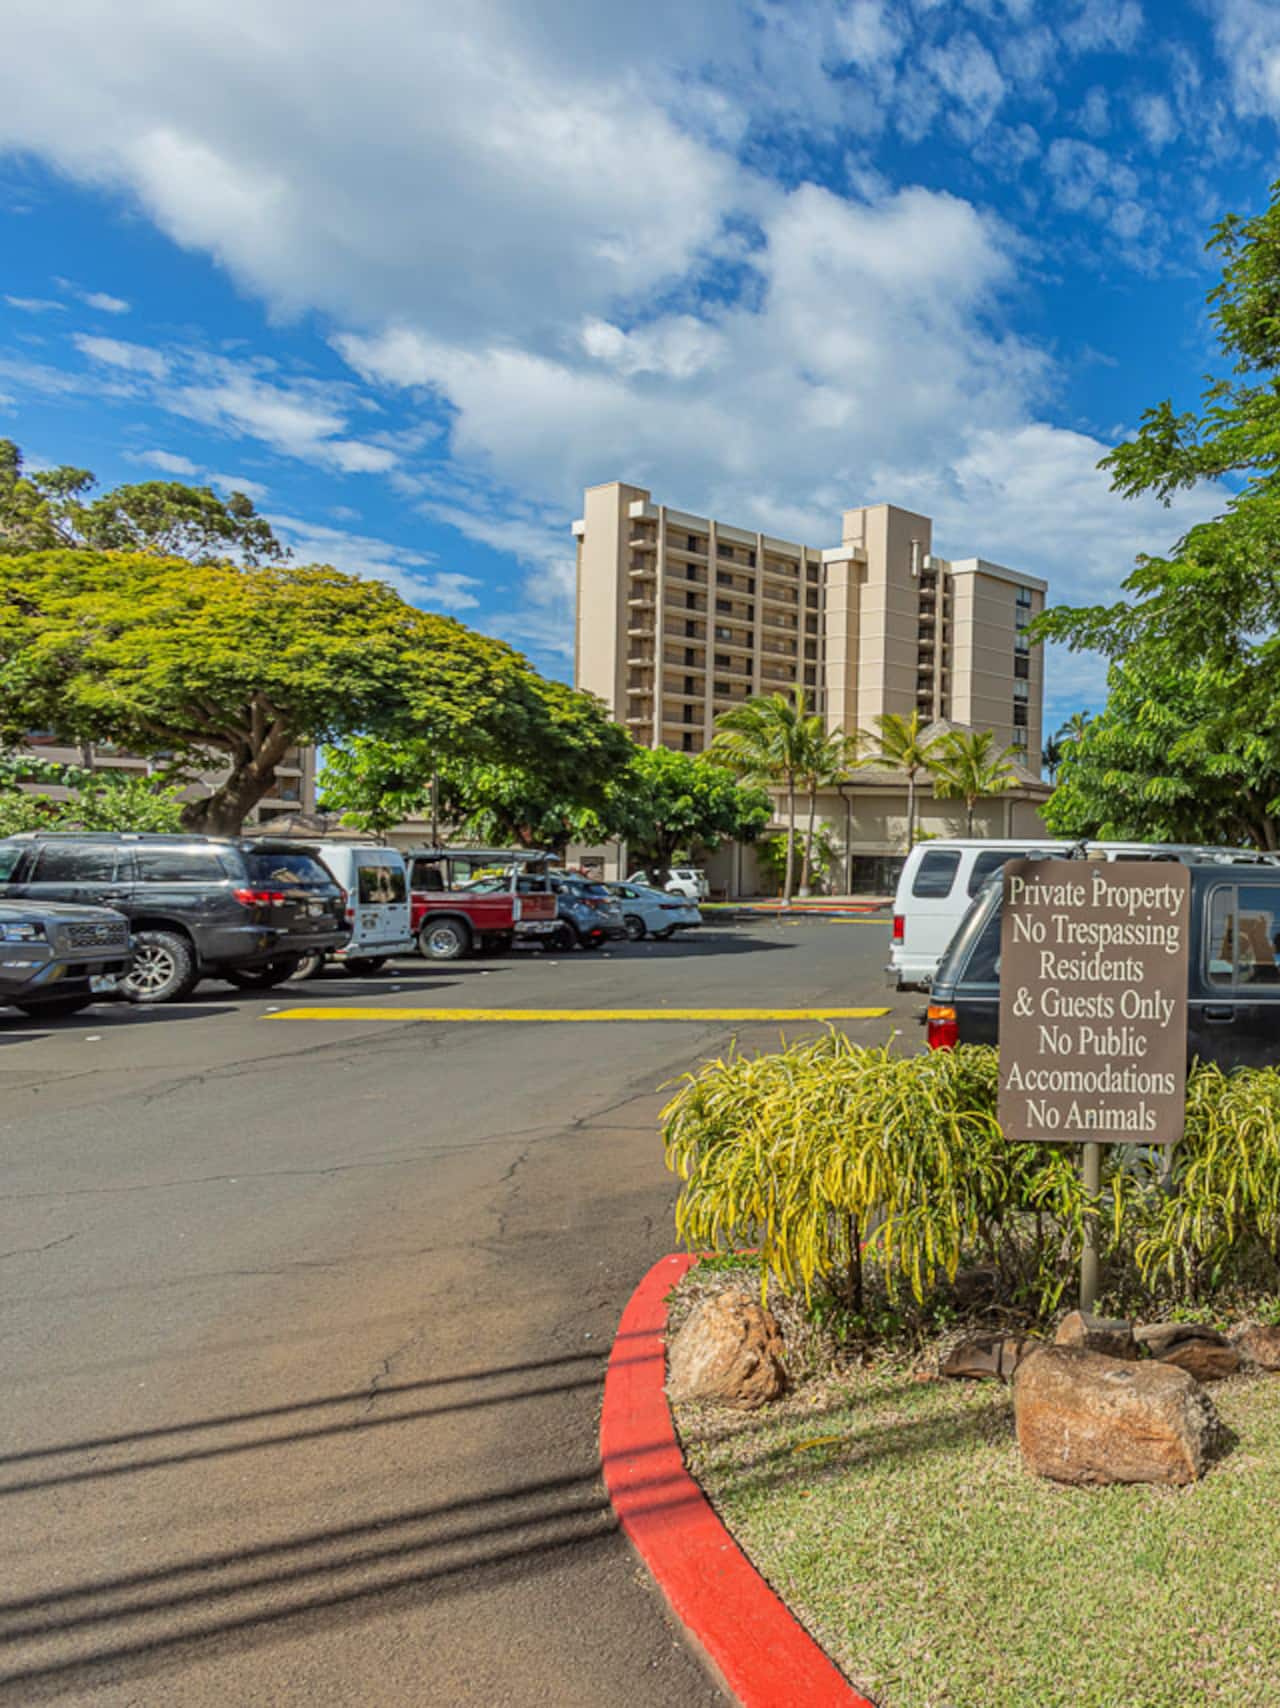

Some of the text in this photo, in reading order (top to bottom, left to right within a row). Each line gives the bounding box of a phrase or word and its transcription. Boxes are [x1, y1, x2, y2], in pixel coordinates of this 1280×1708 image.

[1009, 875, 1184, 916] Private Property
[1012, 913, 1180, 954] No Trespassing
[1039, 951, 1144, 981] Residents
[1012, 986, 1175, 1027] & Guests Only
[1038, 1025, 1147, 1057] No Public
[1006, 1062, 1175, 1094] Accomodations
[1026, 1099, 1157, 1131] No Animals
